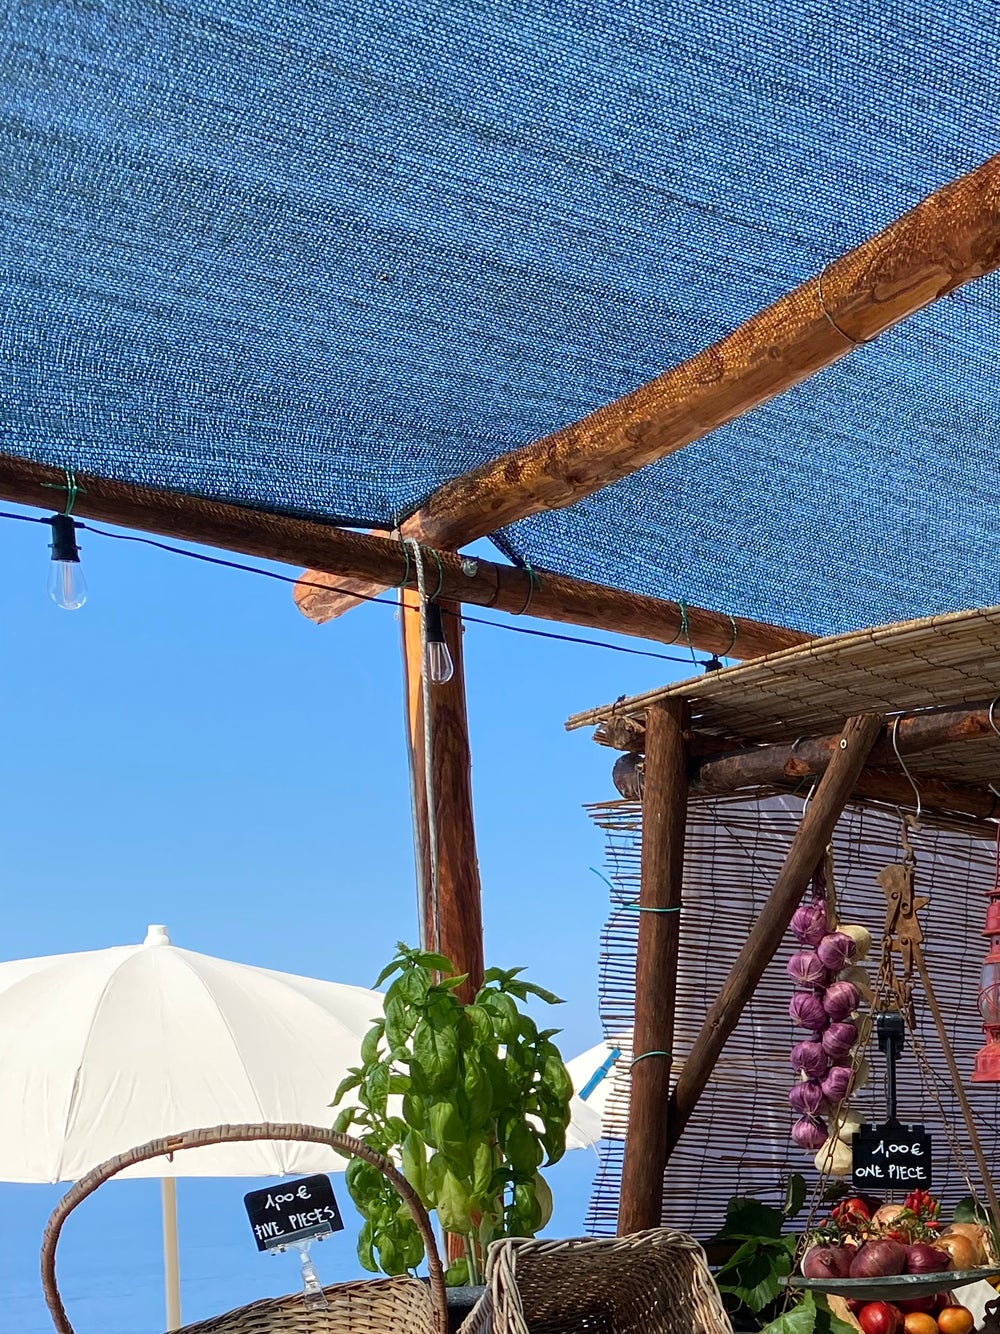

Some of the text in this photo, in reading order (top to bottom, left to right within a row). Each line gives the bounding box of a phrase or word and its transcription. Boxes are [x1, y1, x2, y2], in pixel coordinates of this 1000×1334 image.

[871, 1140, 924, 1158] 1,00€
[855, 1164, 927, 1179] ONE PIECE
[254, 1206, 335, 1240] FIVE PIECES
